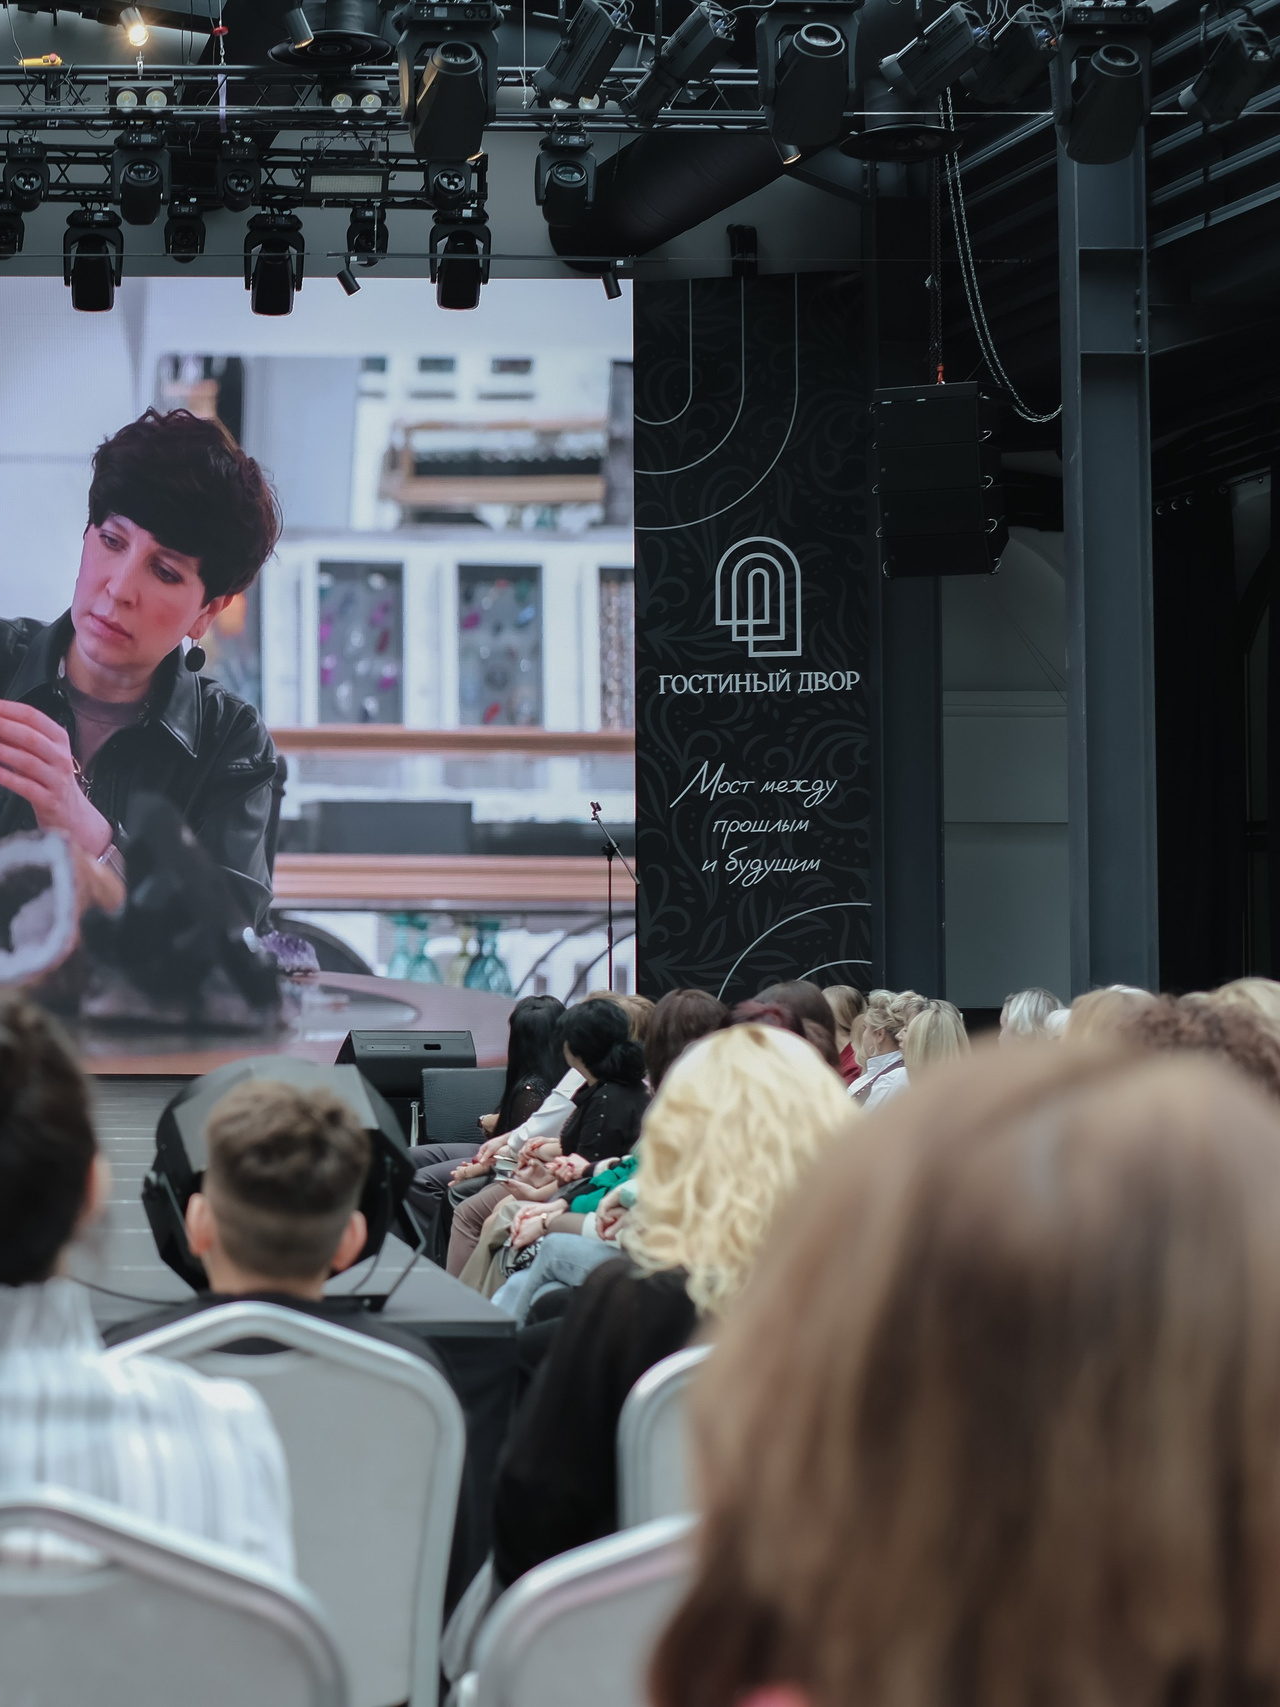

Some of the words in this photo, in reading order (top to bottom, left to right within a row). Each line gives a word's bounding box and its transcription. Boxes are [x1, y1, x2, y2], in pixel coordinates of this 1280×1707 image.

[658, 668, 791, 695] ГОСТИНЫЙ
[797, 670, 861, 694] ДВОР
[669, 760, 756, 809] Мост
[759, 778, 839, 809] между
[712, 818, 810, 850] прошлым
[702, 860, 718, 872] и
[724, 846, 822, 888] будущим
